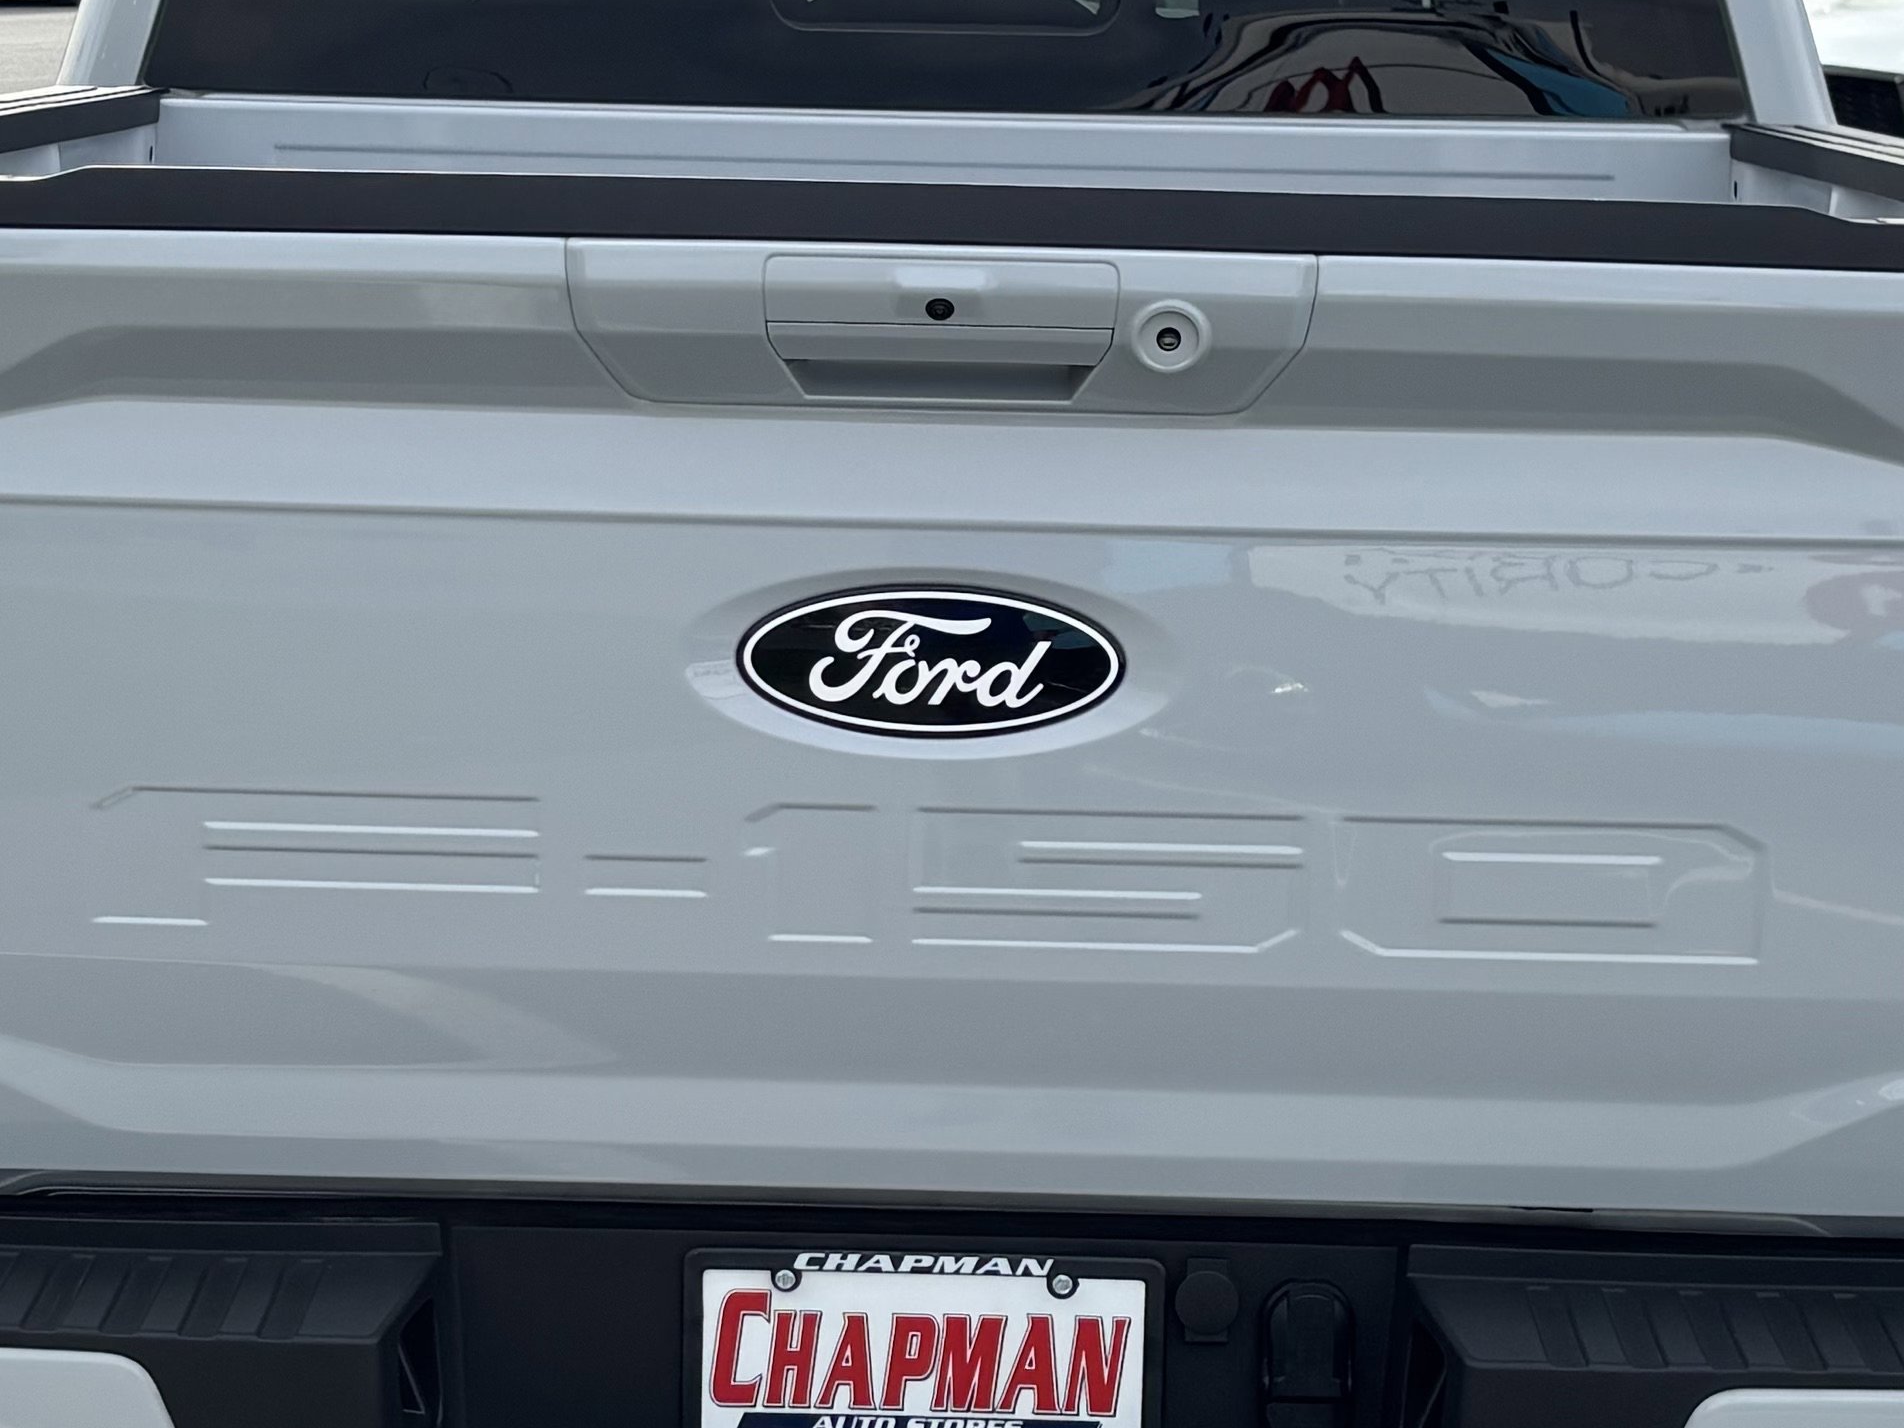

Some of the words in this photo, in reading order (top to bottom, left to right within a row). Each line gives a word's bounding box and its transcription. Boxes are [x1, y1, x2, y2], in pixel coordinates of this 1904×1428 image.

[809, 610, 1053, 709] Ford
[92, 785, 1764, 966] F-150
[794, 1252, 1056, 1277] CHAPMAN
[709, 1287, 1132, 1417] CHAPMAN
